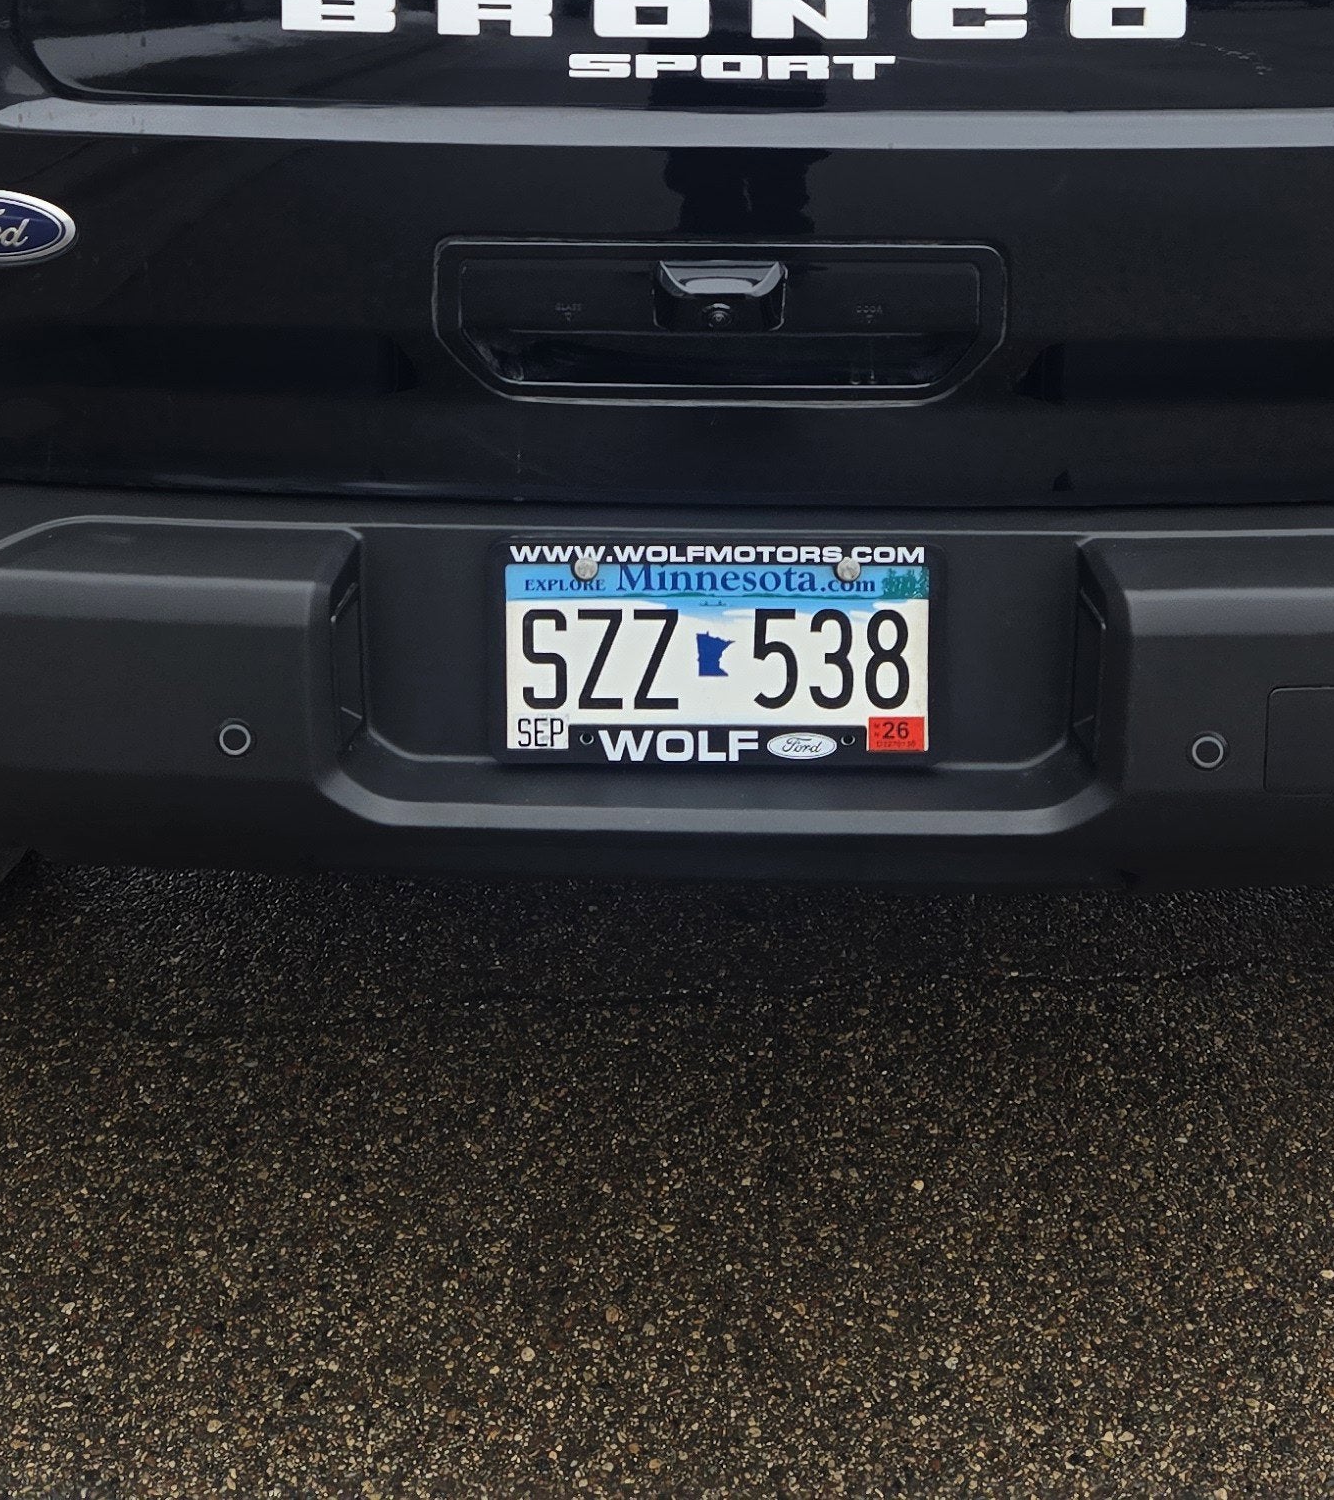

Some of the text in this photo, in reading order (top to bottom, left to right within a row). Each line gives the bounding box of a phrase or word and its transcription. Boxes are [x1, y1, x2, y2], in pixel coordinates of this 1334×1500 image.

[567, 53, 897, 81] SPORT
[509, 545, 925, 564] WWW.WOLFMOTORS.COM
[524, 579, 606, 592] EXPLORE
[522, 609, 909, 710] SZZ 538
[517, 718, 564, 747] SEP
[882, 721, 910, 740] 26
[598, 730, 823, 762] WOLF Ford
